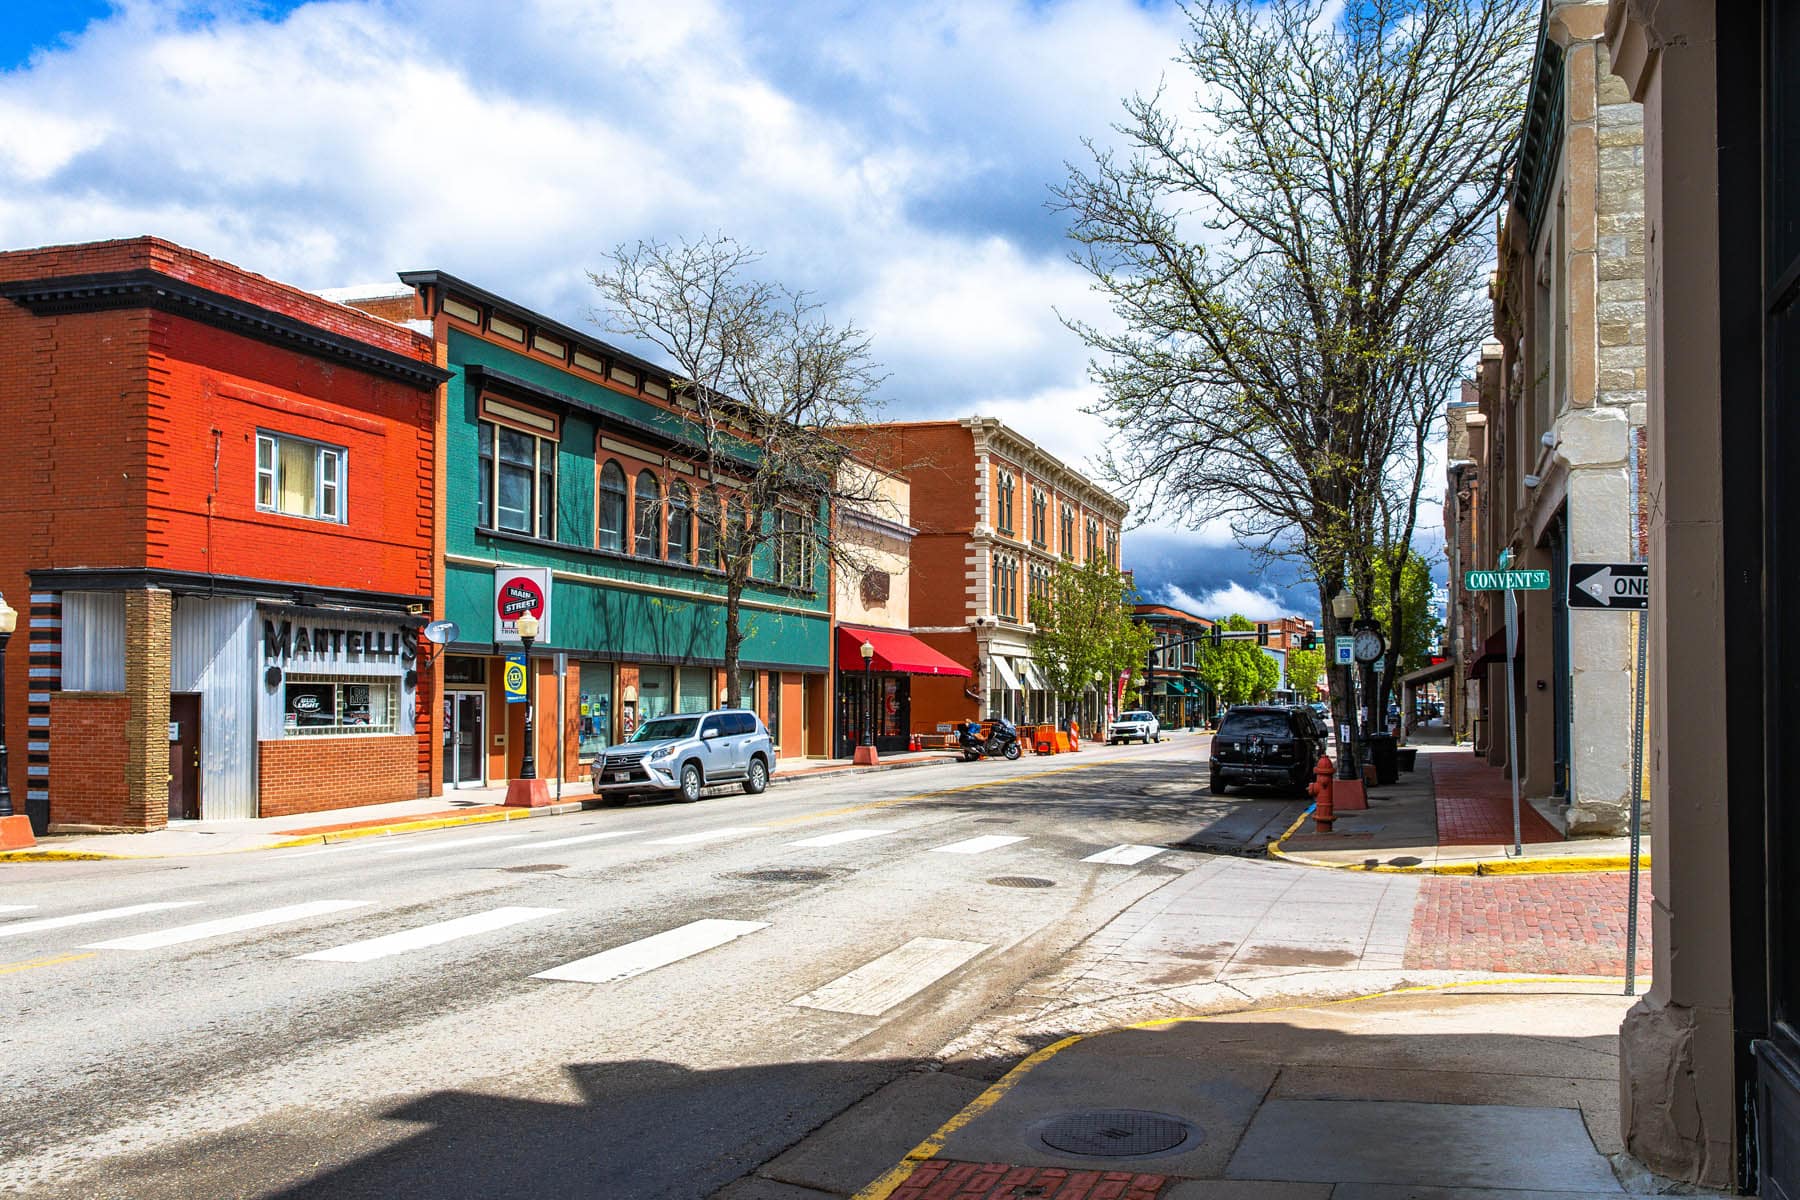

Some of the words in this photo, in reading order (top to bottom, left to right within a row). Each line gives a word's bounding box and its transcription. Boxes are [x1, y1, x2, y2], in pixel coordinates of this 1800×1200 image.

[1470, 572, 1533, 588] CONVENT
[1533, 572, 1545, 583] ST
[510, 588, 532, 598] MAIN
[506, 598, 536, 612] STREET
